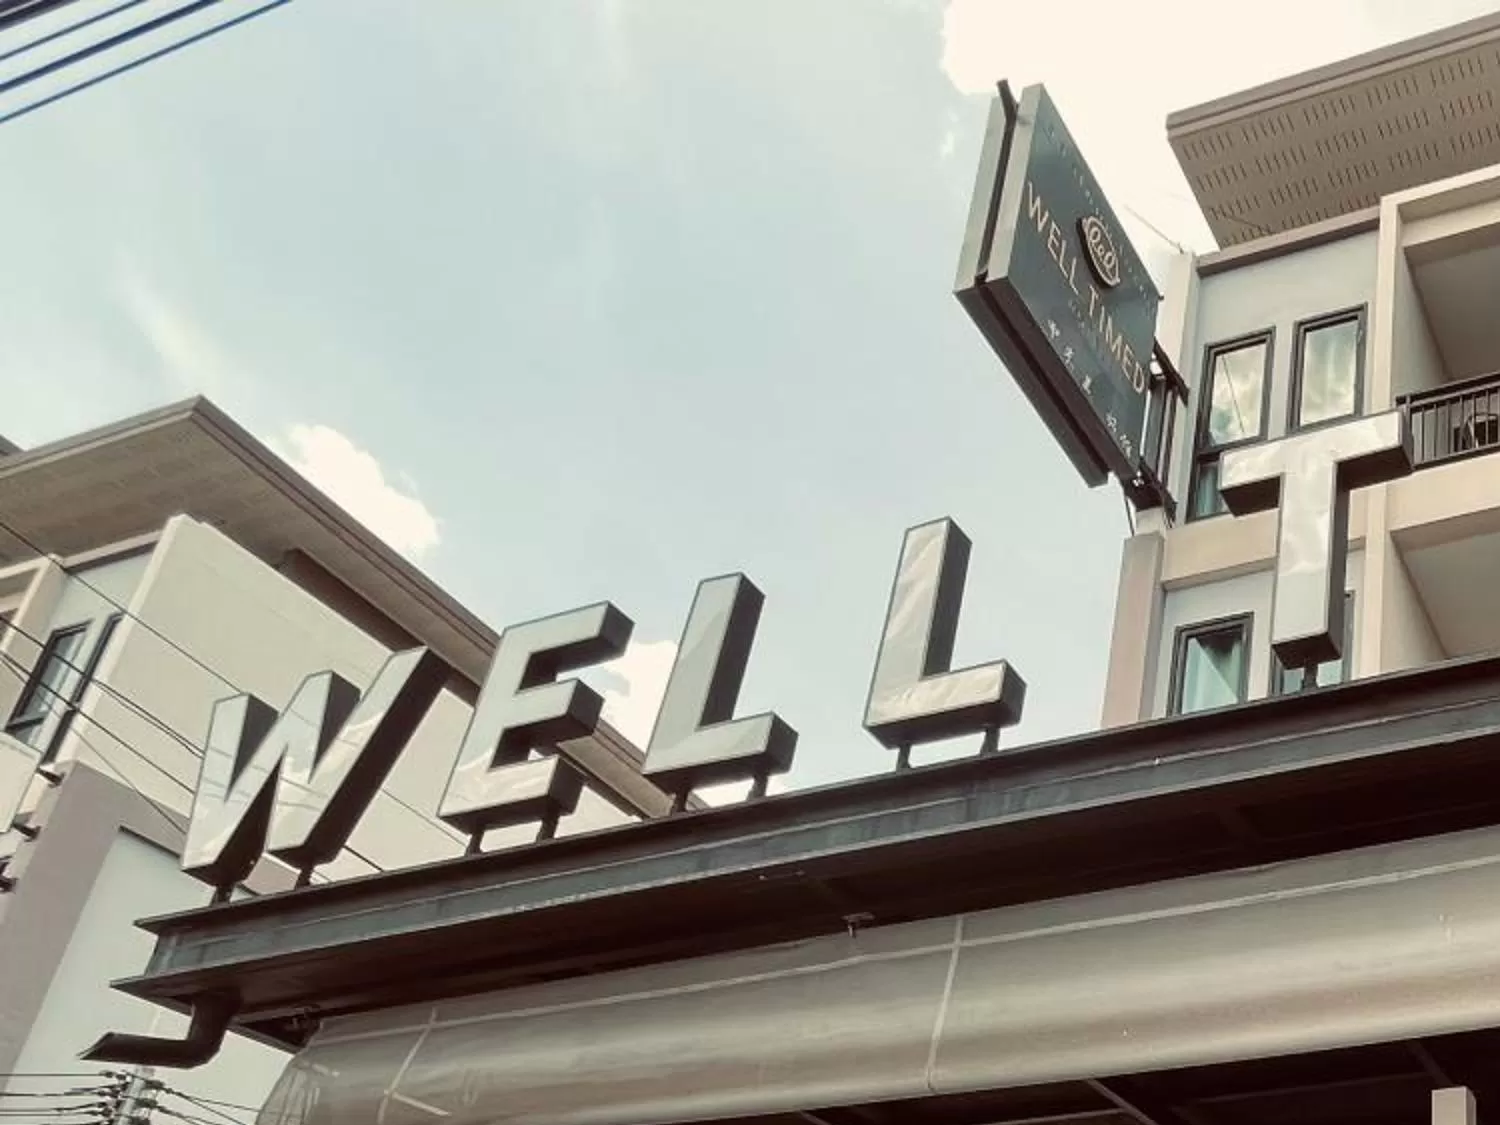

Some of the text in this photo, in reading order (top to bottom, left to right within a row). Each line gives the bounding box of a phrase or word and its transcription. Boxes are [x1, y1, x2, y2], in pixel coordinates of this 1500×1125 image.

[1026, 179, 1080, 296] WELL
[1087, 283, 1146, 395] TIMED
[182, 517, 1026, 886] WELL
